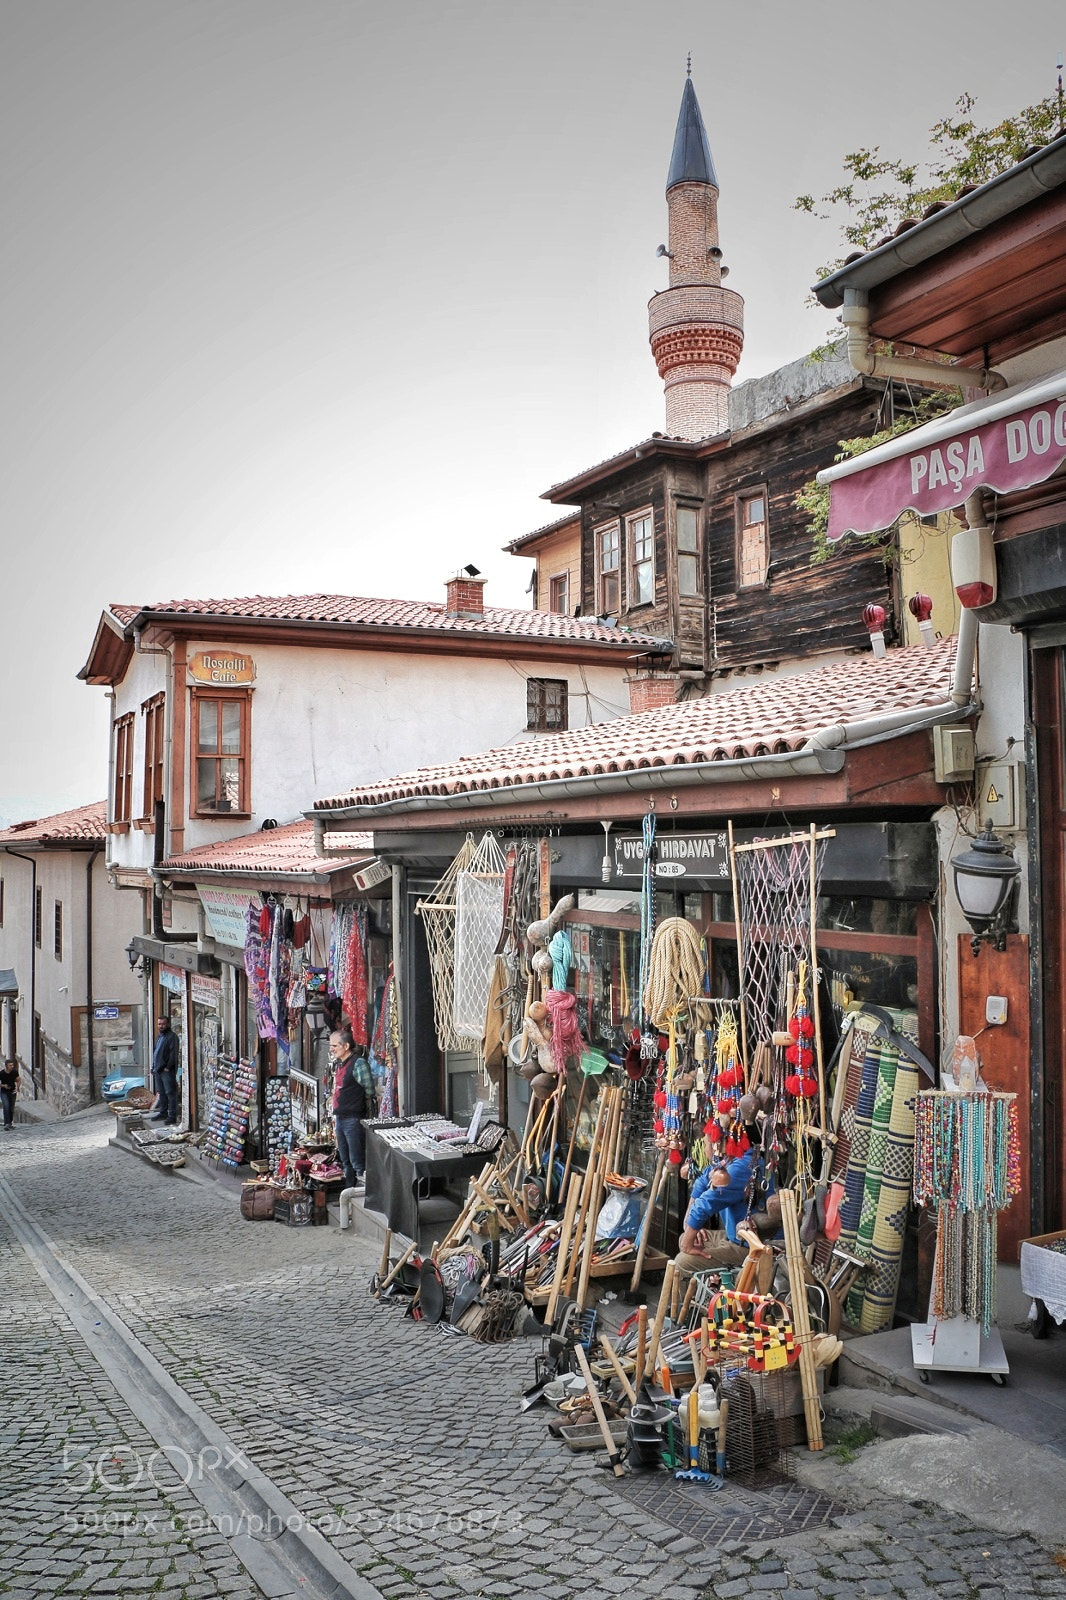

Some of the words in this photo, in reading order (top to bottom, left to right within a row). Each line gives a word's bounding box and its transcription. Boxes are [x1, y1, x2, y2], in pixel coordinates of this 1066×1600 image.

[910, 435, 985, 494] PAŞA
[203, 656, 245, 672] Nostalji
[211, 670, 236, 682] Cafe
[660, 839, 716, 858] HIRDAVAT
